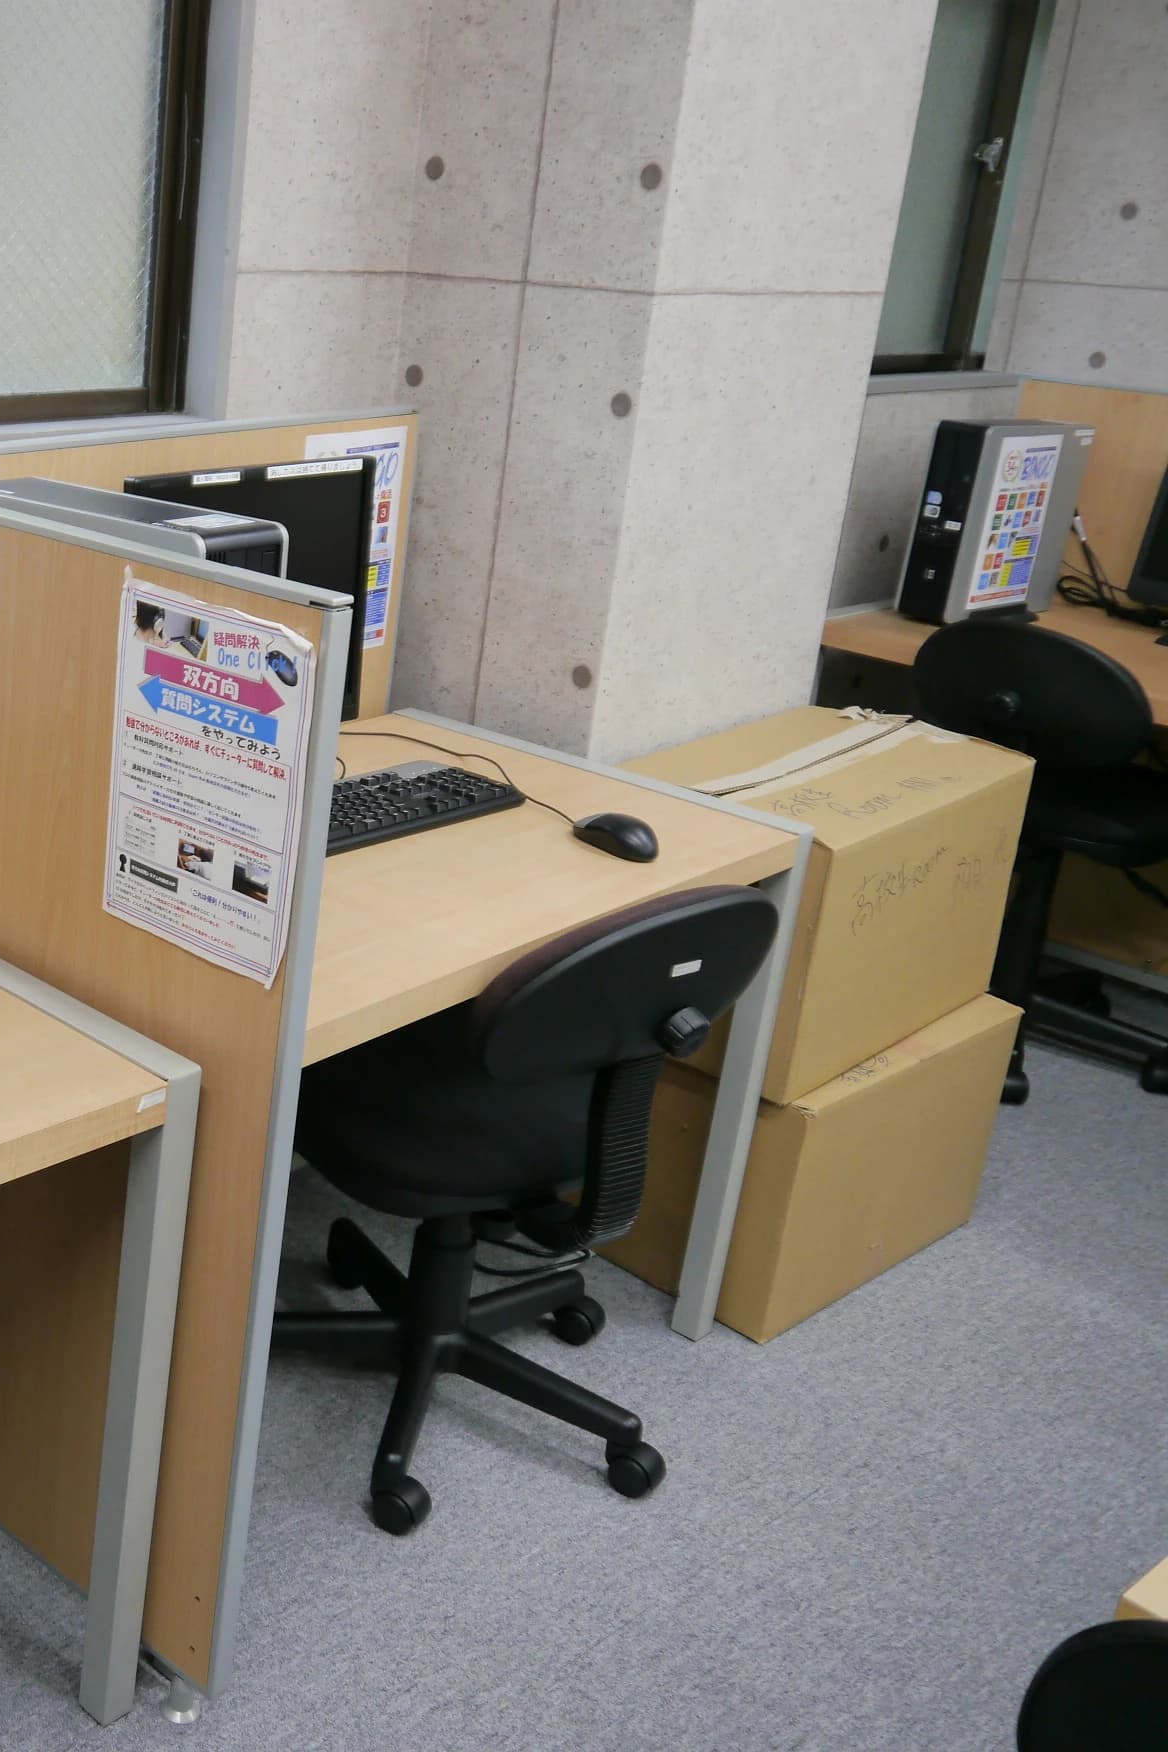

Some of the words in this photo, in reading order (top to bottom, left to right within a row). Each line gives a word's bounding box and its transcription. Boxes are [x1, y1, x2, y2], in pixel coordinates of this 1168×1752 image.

[213, 631, 261, 650] 疑問解決
[217, 648, 240, 668] One
[183, 664, 240, 701] 双方向
[160, 687, 256, 734] 質問システム
[201, 725, 281, 761] をやってみよう
